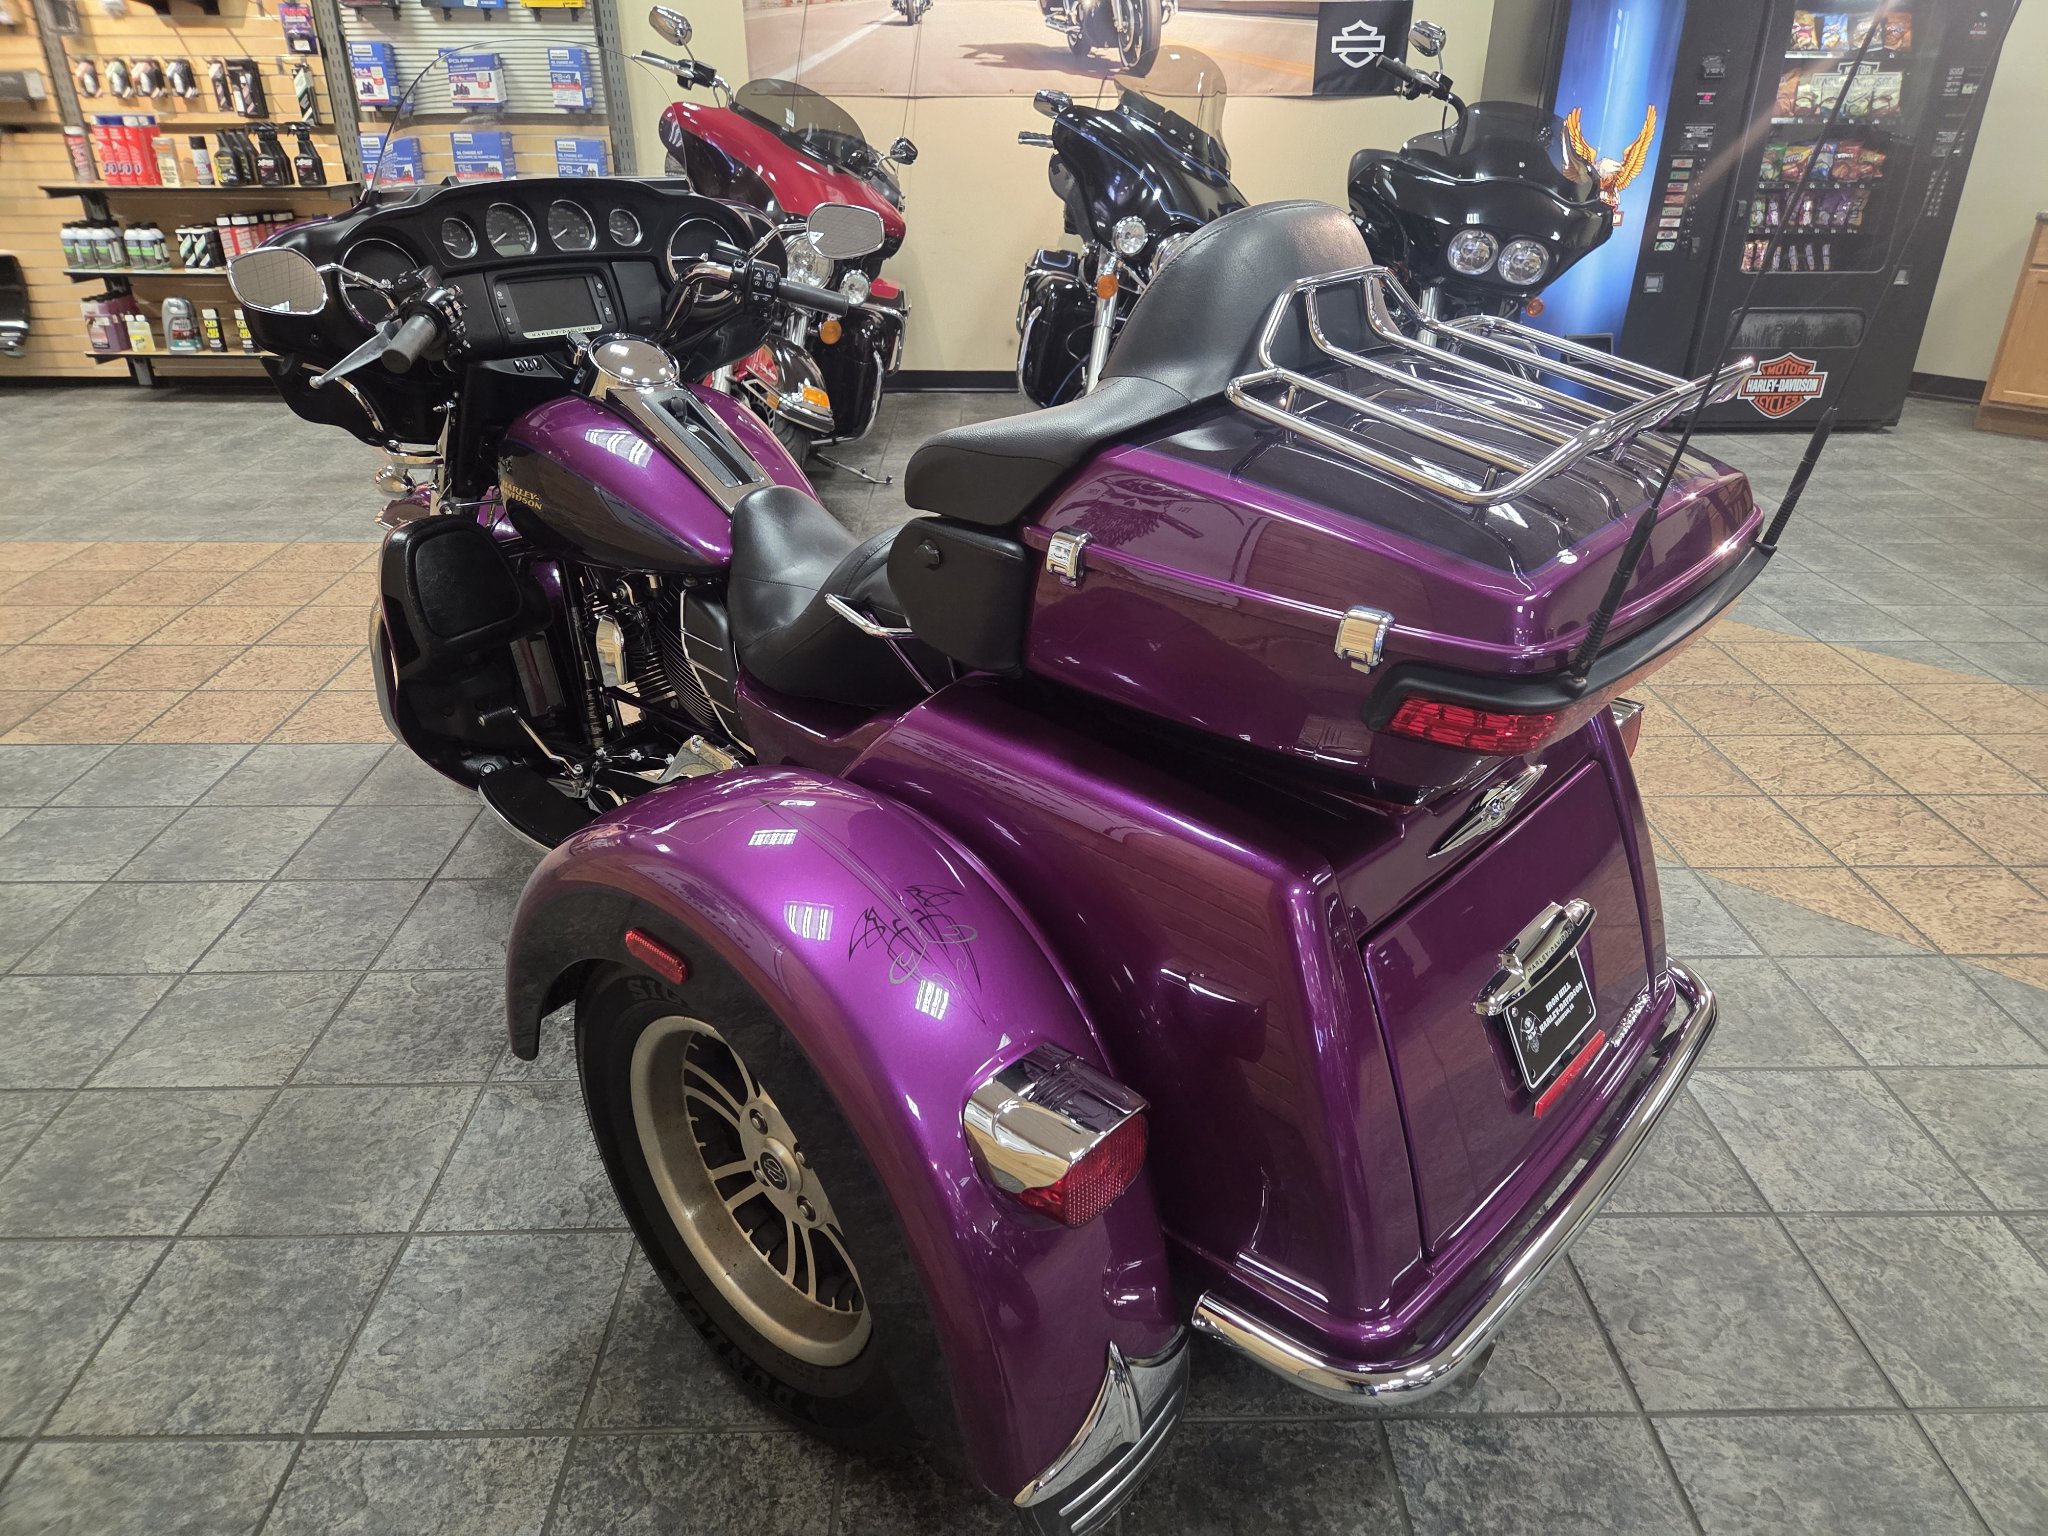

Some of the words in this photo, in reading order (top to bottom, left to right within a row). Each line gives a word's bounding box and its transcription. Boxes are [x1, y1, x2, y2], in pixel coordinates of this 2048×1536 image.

[1767, 360, 1806, 375] MOTOR
[1745, 378, 1819, 393] HARLEY-DAVIDSON
[1759, 395, 1799, 413] CYCLES
[501, 479, 540, 501] HARLEY-
[1527, 921, 1576, 973] HARLEY-DAVIDSON
[1538, 981, 1583, 1033] HARLEY-DAVIDSON
[1546, 993, 1560, 1012] IRON
[1559, 981, 1572, 998] HILL
